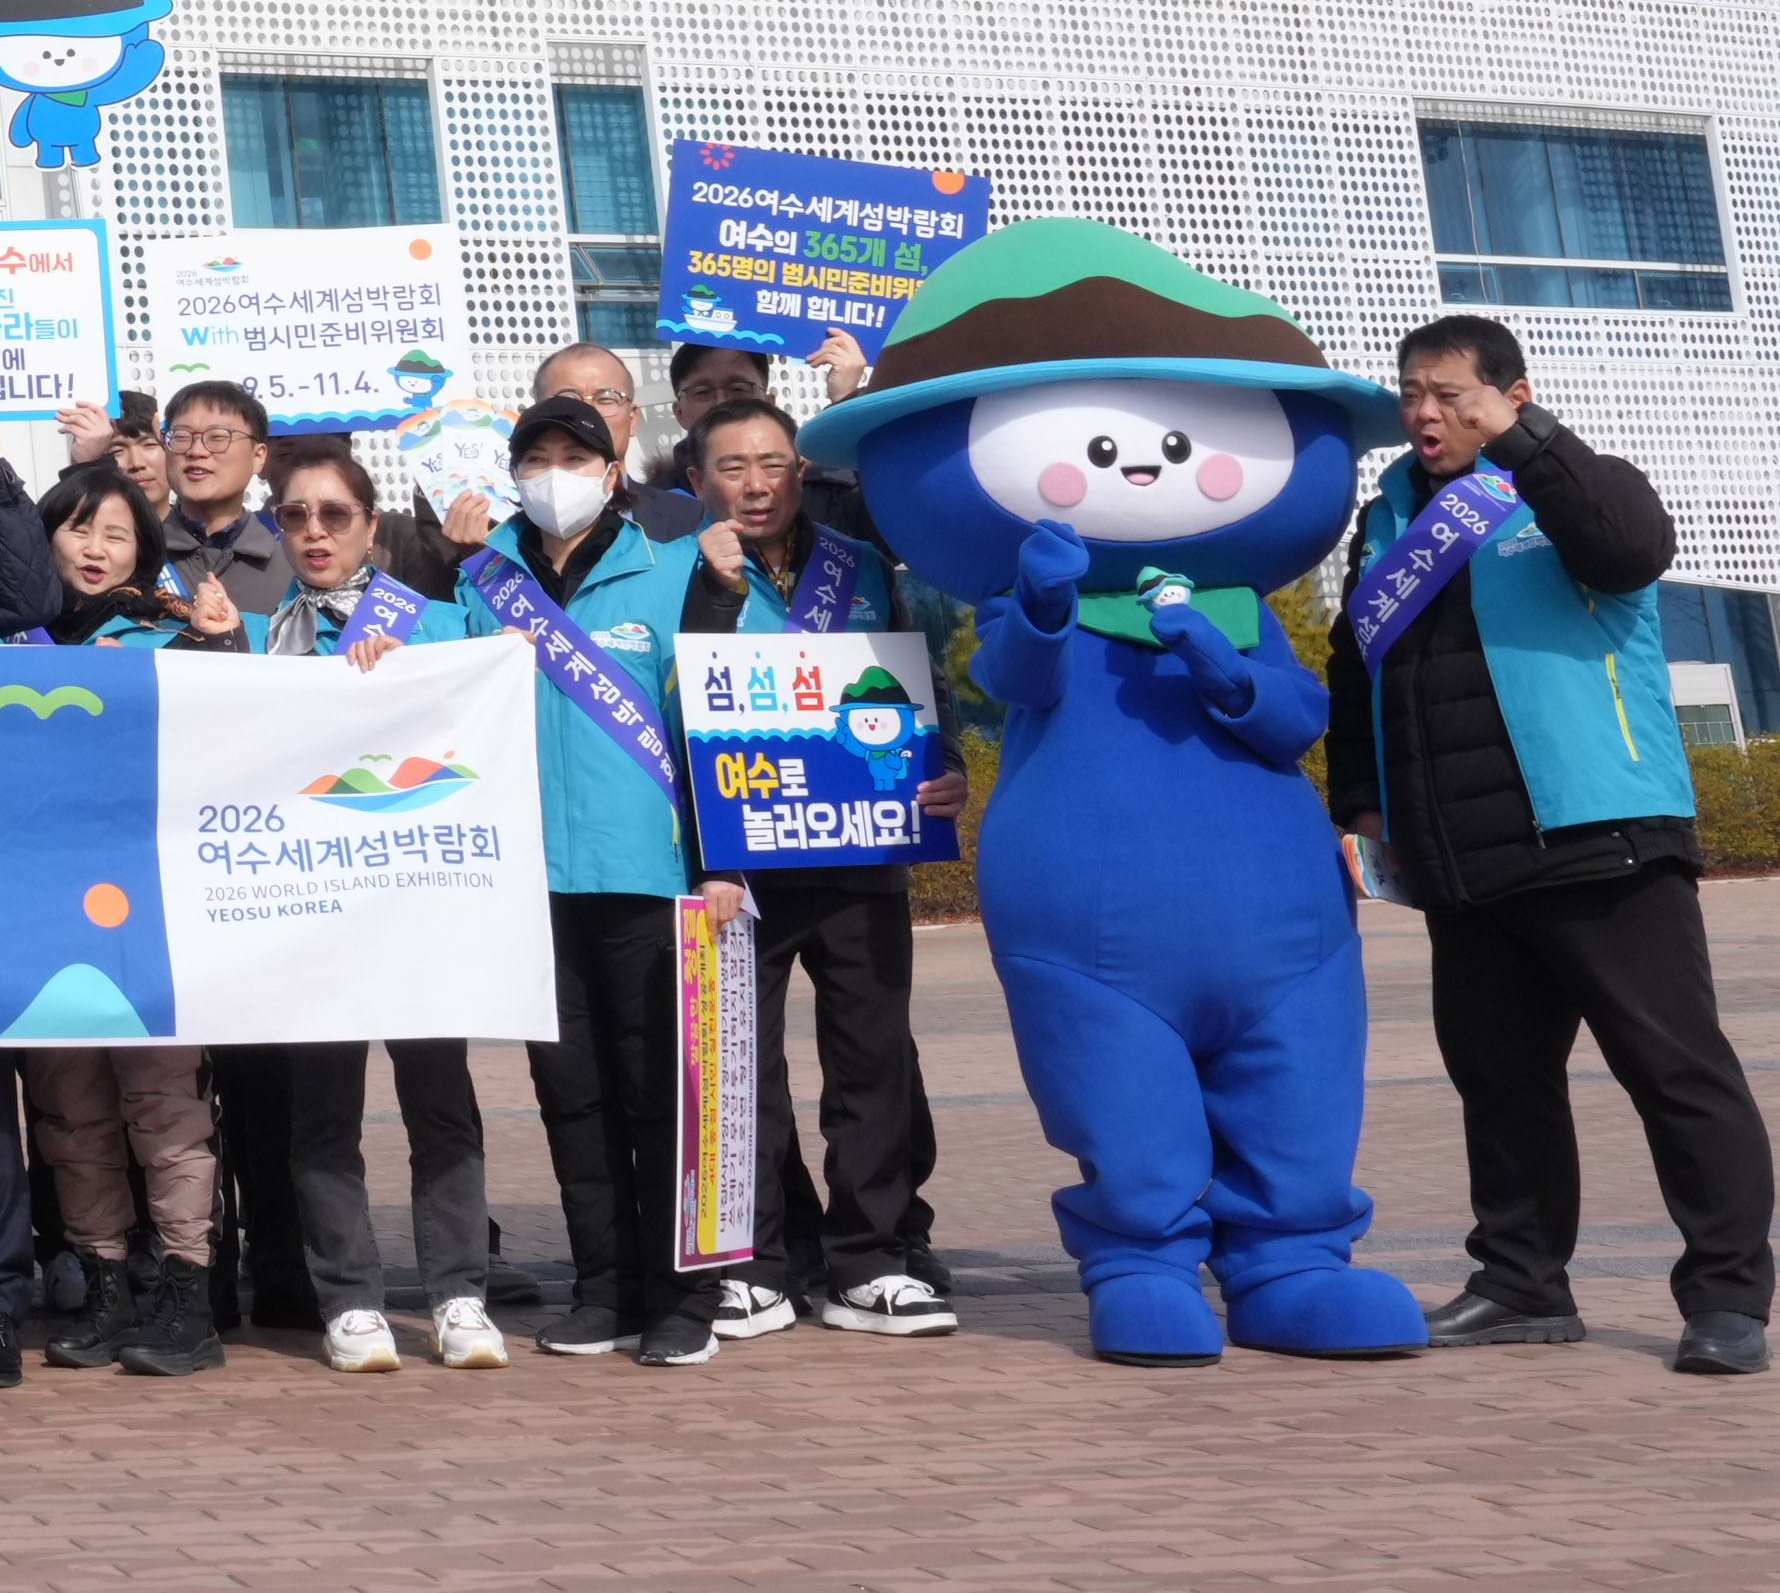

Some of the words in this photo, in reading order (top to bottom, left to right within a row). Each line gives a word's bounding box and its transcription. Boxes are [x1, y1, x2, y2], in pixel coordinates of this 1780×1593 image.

[691, 181, 964, 240] 2026여수세계섬박람회
[719, 219, 797, 256] 여수의
[803, 230, 886, 264] 365개
[894, 241, 929, 275] 섬,
[687, 250, 775, 284] 365명의
[177, 282, 441, 316] 2026여수세계섬박람회
[756, 289, 801, 318] 함께
[807, 295, 885, 329] 합니다!
[243, 316, 445, 352] 범시민준비위원회
[1440, 493, 1490, 536] 2026
[820, 537, 856, 569] 2026
[371, 588, 416, 615] 2026
[491, 572, 525, 610] 2026
[715, 752, 808, 799] 여수로
[198, 803, 285, 834] 2026
[742, 800, 920, 851] 놀러오세요!
[197, 823, 501, 876] 여수세계섬박람회
[205, 886, 247, 902] 2026
[251, 880, 319, 900] WORLD
[324, 873, 391, 894] ISLAND
[395, 871, 494, 890] EXHIBITION
[206, 905, 271, 924] YEOSU
[277, 898, 344, 918] KOREA
